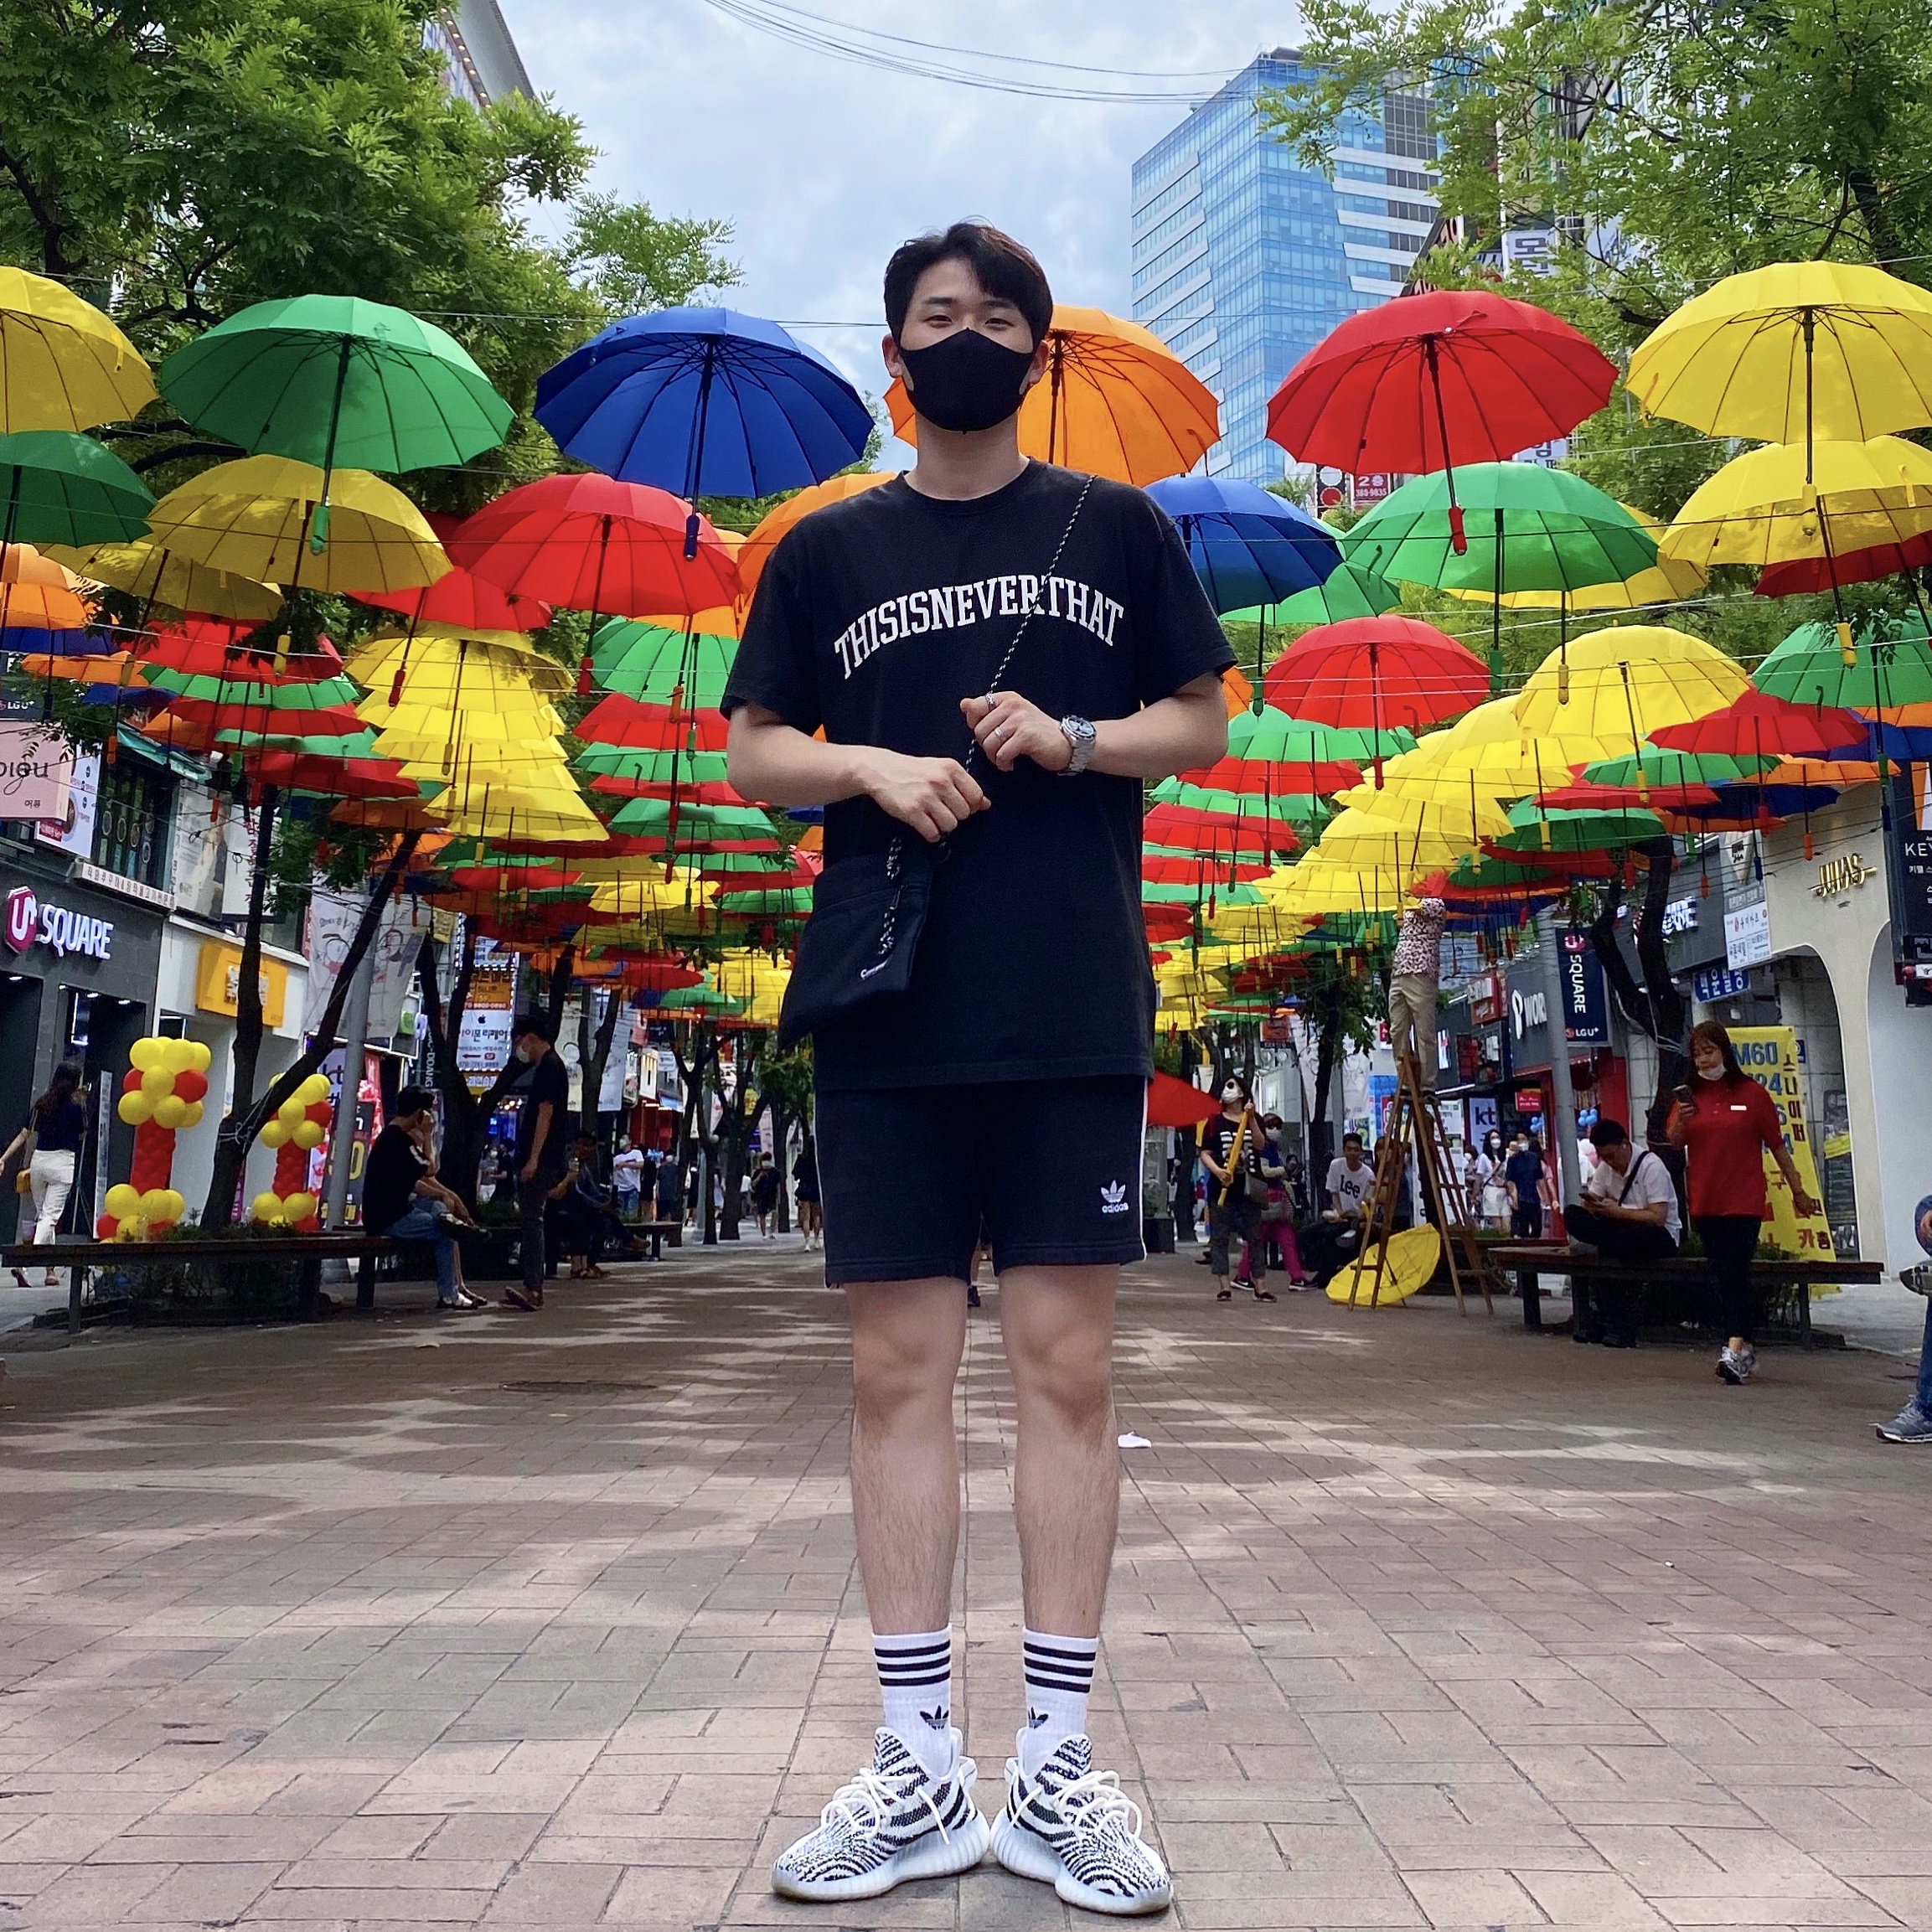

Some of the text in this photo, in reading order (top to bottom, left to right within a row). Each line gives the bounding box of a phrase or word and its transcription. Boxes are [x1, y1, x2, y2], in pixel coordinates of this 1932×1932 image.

[834, 574, 1124, 680] THISISNEVERTHAT
[39, 903, 114, 960] SQUARE
[1568, 954, 1587, 1014] SQUARE
[1475, 1106, 1495, 1126] kt
[1340, 1174, 1361, 1199] Lee
